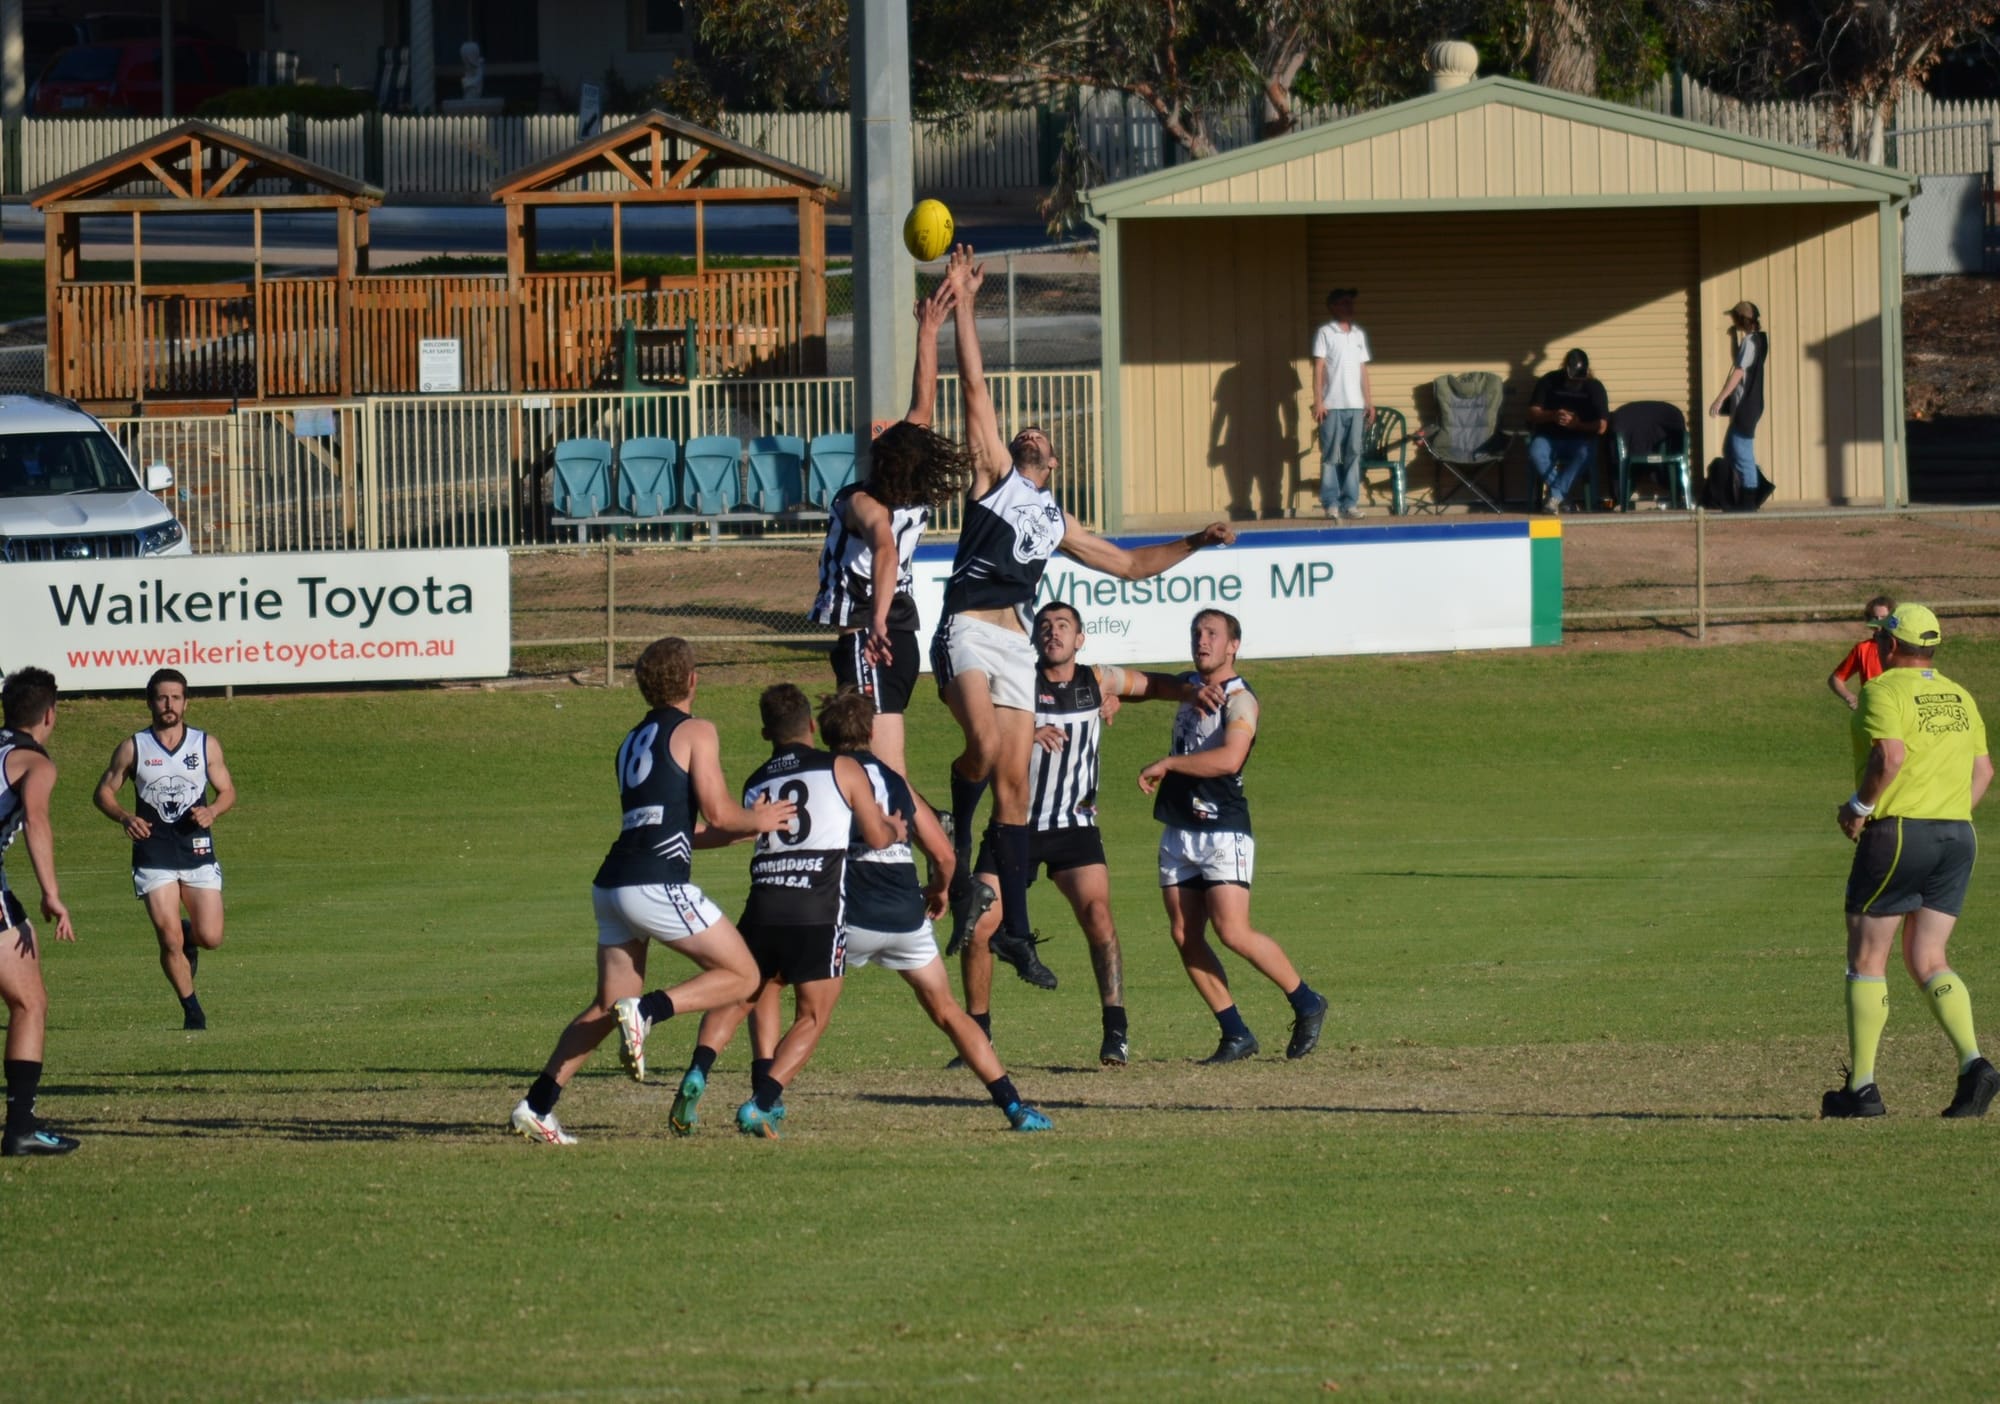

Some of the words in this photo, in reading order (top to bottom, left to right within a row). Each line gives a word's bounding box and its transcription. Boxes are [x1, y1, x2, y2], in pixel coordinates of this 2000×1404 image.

[1271, 562, 1333, 598] MP
[49, 578, 282, 627] Waikerie
[297, 576, 473, 629] Toyota
[1081, 616, 1131, 637] affey
[67, 639, 454, 668] www.waikerietoyota.com.au
[619, 722, 659, 793] 18
